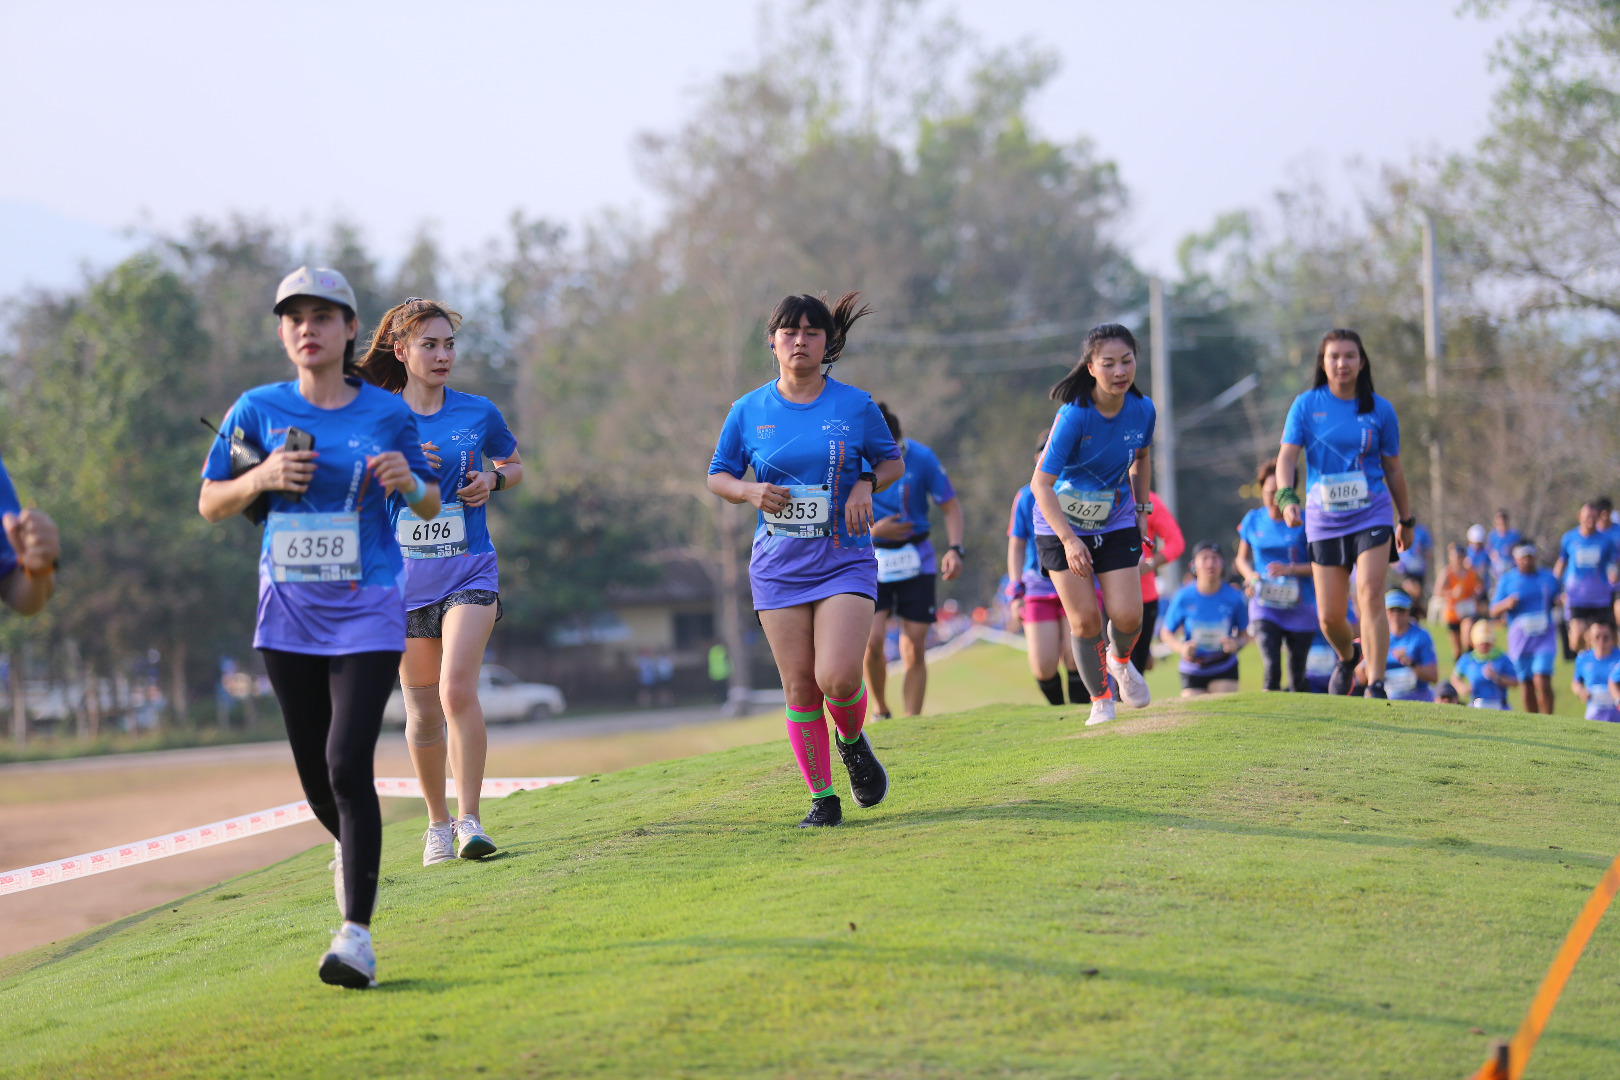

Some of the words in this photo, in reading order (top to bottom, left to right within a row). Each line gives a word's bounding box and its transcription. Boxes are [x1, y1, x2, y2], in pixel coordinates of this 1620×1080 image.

[835, 441, 846, 473] SINGHA
[833, 475, 842, 497] PARK
[1329, 483, 1359, 500] 6186
[1067, 502, 1102, 517] 6167
[412, 521, 451, 541] 6196
[287, 536, 344, 558] 6358
[833, 534, 842, 549] RAI
